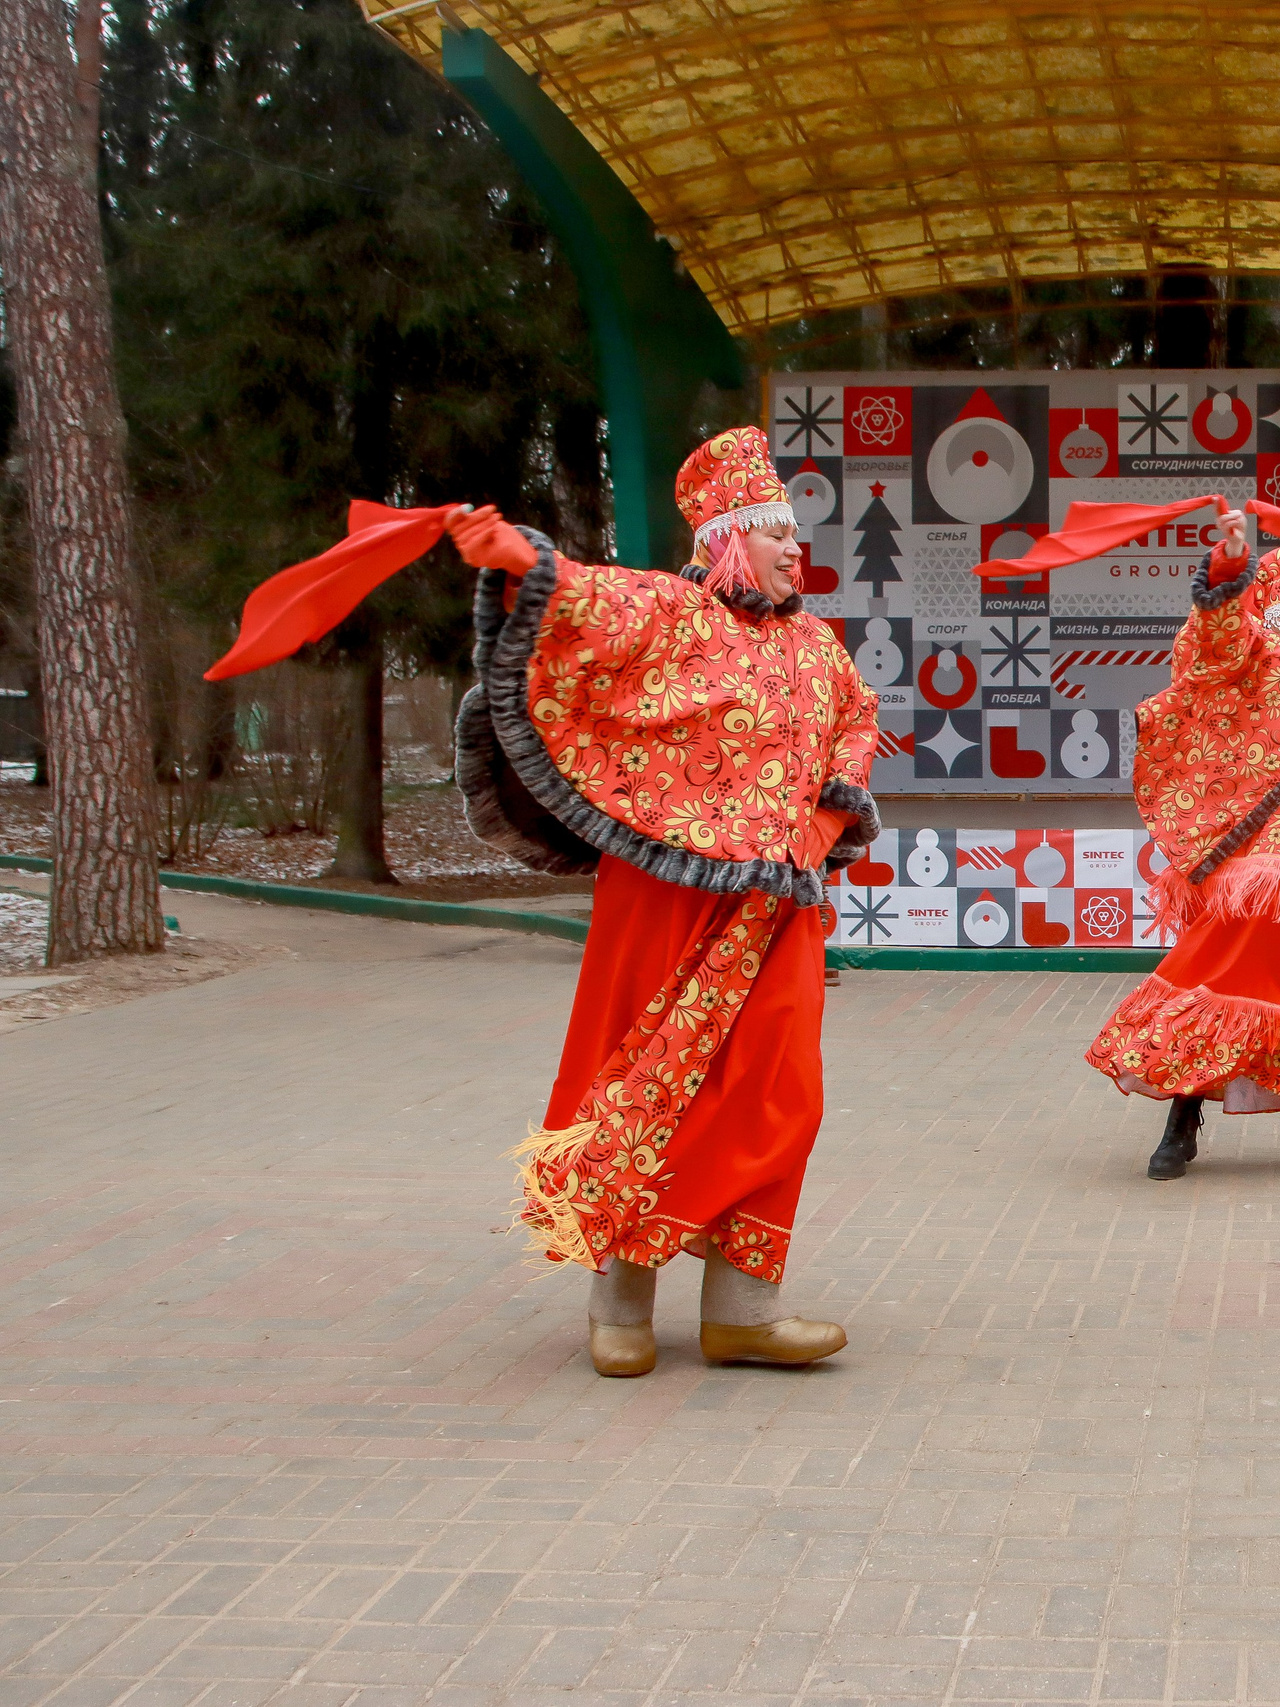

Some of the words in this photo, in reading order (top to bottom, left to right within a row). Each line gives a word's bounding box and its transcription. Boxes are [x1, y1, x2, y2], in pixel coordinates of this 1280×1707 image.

[1064, 446, 1104, 459] 2025
[845, 461, 910, 473] ЗДОРОВЬЕ
[1131, 459, 1244, 471] СОТРУДНИЧЕСТВО
[926, 531, 967, 542] СЕМЬЯ
[1109, 565, 1197, 577] GROUP
[985, 599, 1046, 611] КОМАНДА
[927, 625, 967, 635] СПОРТ
[1055, 625, 1099, 634] ЖИЗНЬ
[1102, 625, 1110, 634] В
[991, 693, 1041, 705] ПОБЕДА
[1082, 851, 1125, 859] SINTEC
[907, 909, 949, 918] SINTEC
